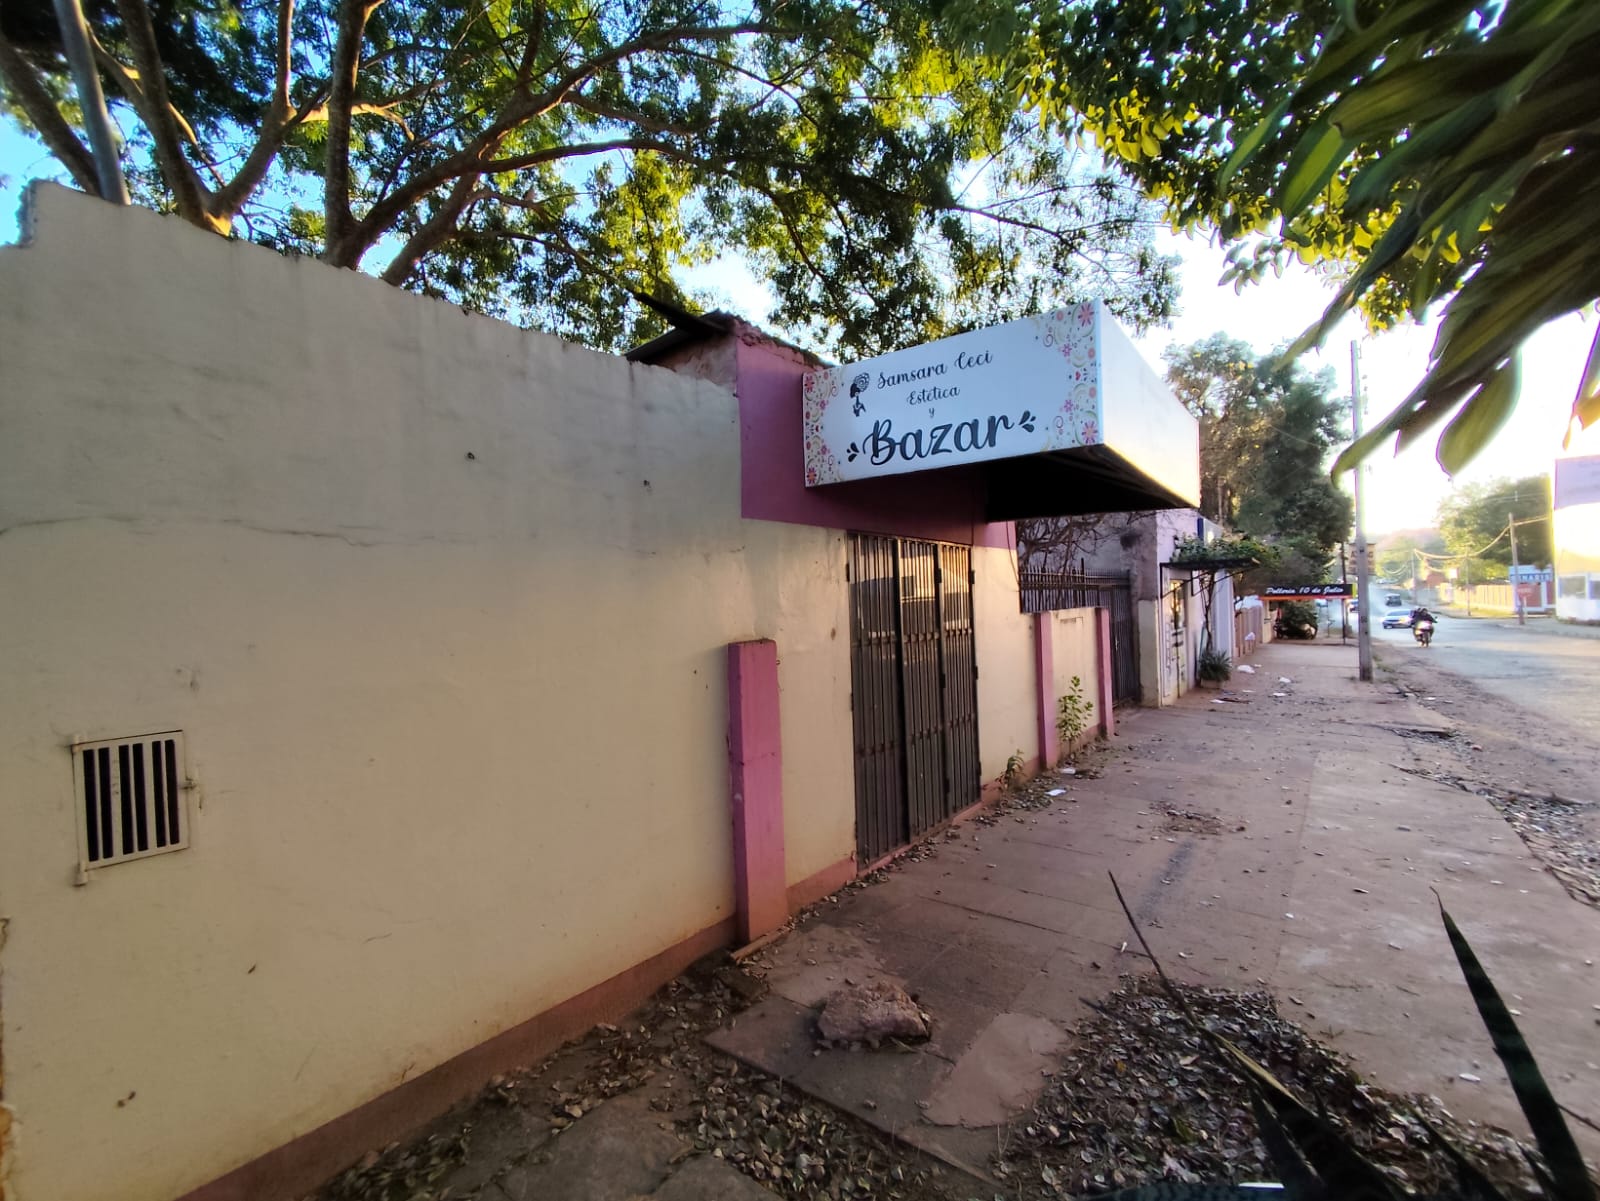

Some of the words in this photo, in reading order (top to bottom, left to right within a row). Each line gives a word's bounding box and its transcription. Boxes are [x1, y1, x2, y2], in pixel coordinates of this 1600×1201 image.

[877, 363, 947, 390] Samsara
[928, 407, 936, 419] y
[862, 414, 1014, 466] Bazar
